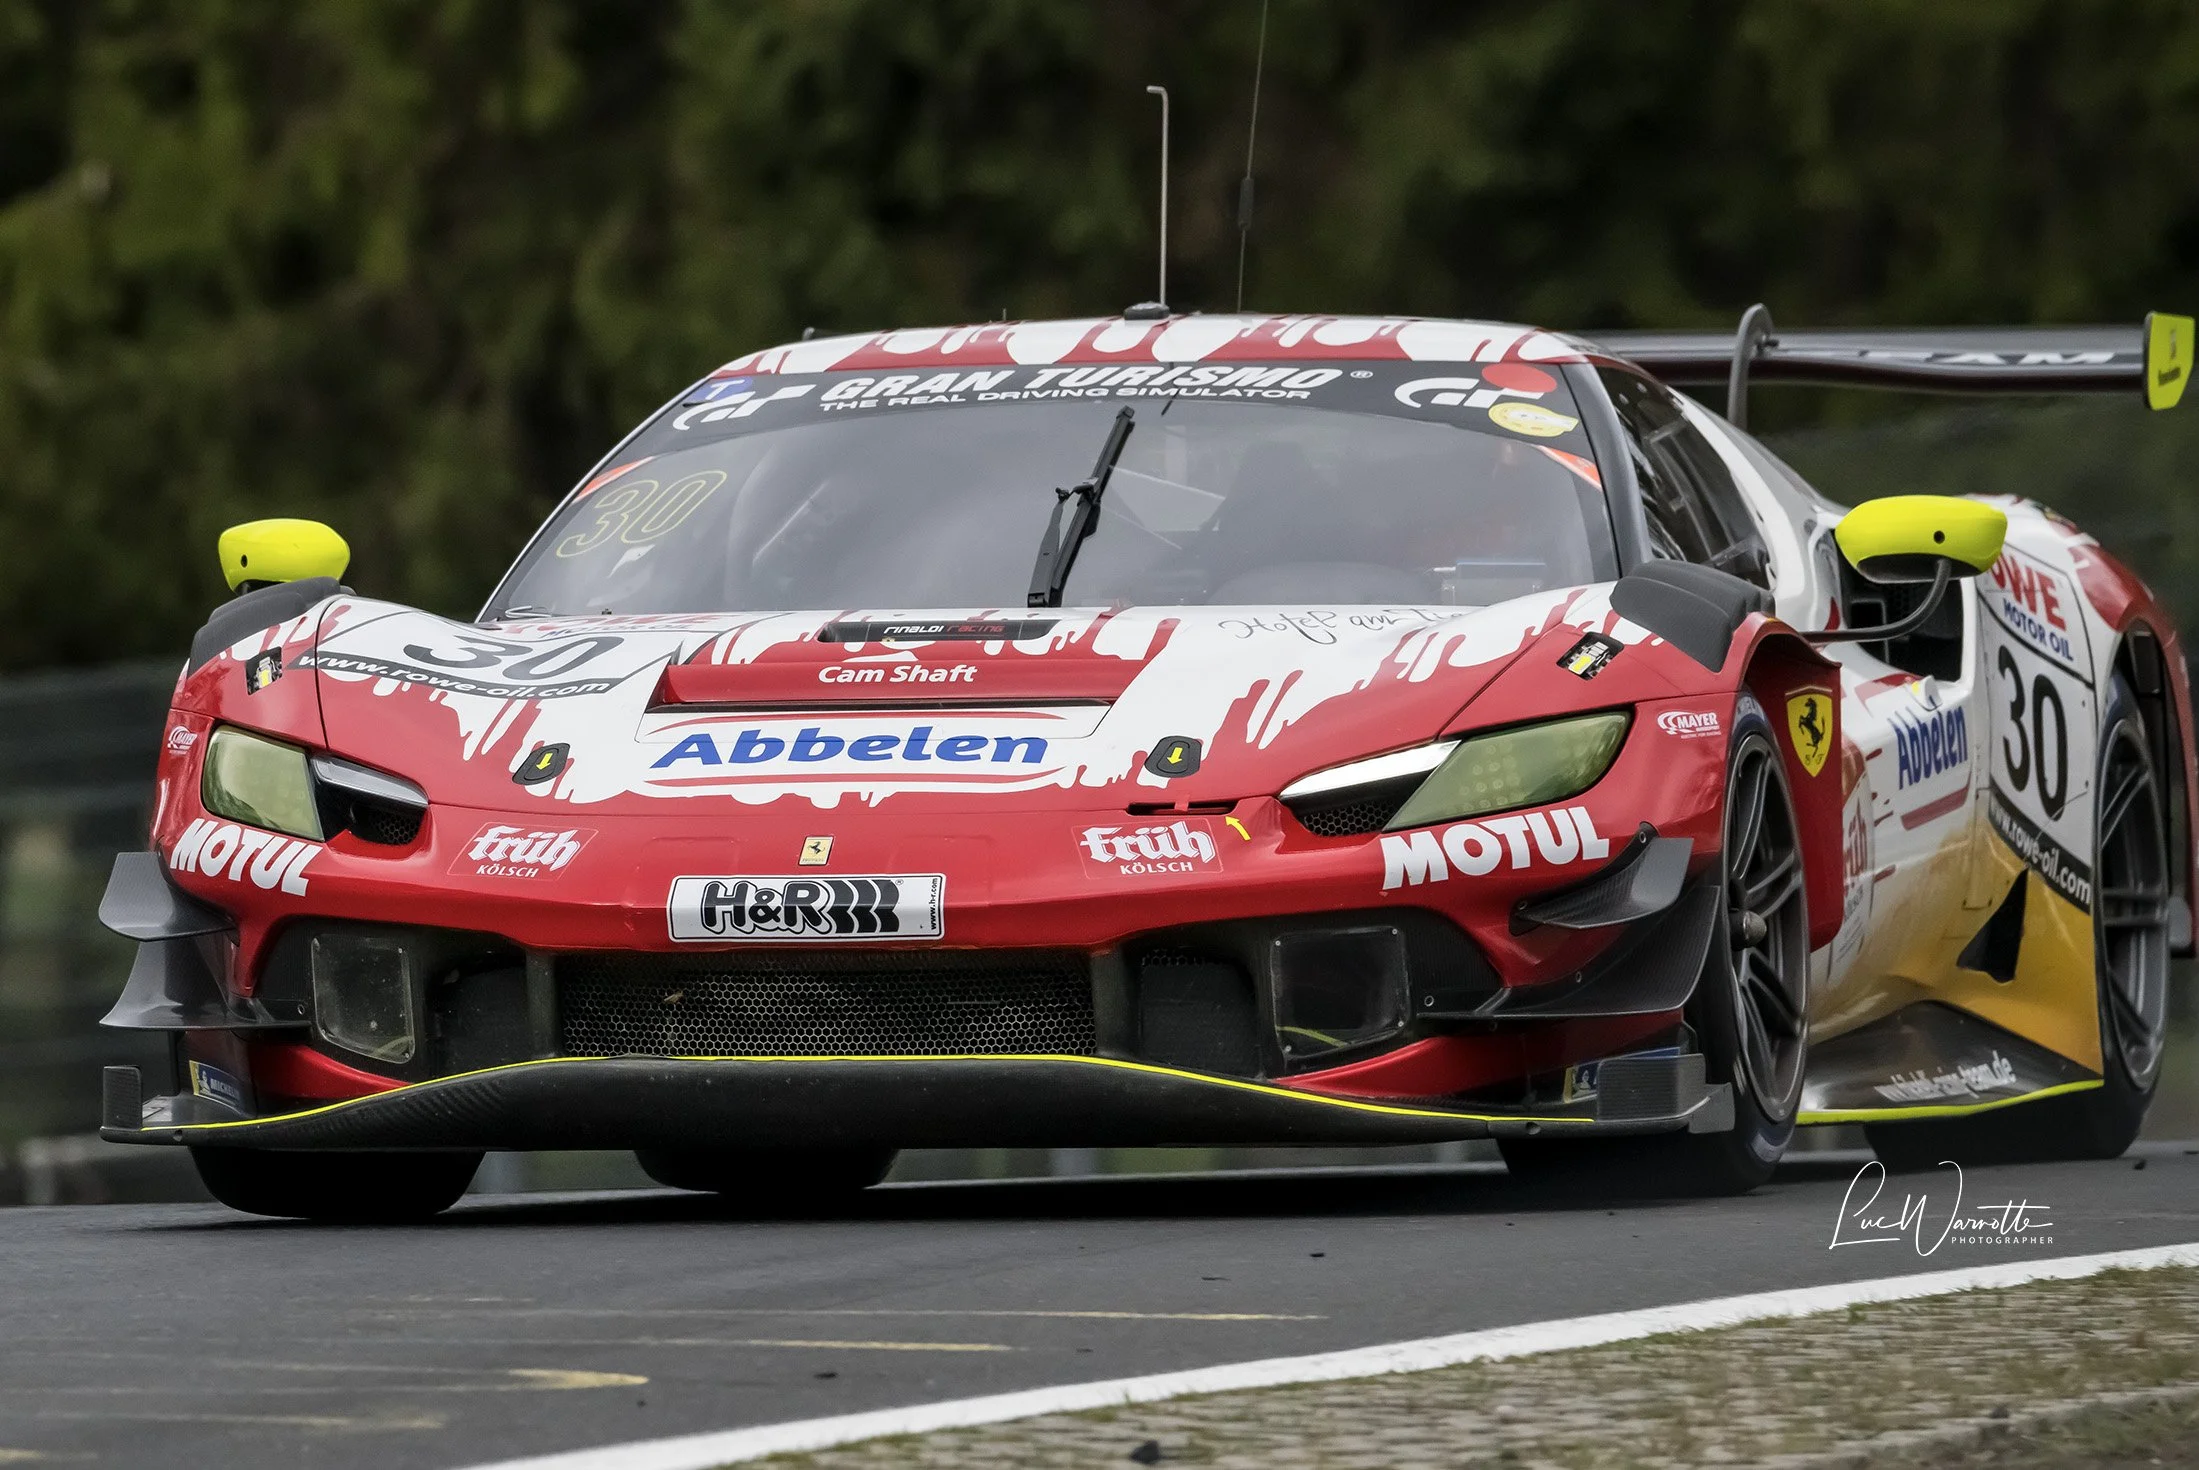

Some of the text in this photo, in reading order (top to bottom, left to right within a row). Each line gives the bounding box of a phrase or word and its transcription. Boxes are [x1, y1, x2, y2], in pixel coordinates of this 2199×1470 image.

[820, 387, 1311, 411] THE REAL DRIVING SIMULATOR
[821, 366, 1344, 401] GRAN TURISMO
[556, 470, 728, 558] 30
[1989, 552, 2067, 632] OWE
[2003, 597, 2074, 662] MOTOR OIL
[299, 654, 610, 698] www.rowe-oil.com
[403, 635, 625, 680] 30
[818, 663, 978, 684] Cam Shaft
[1676, 712, 1719, 729] MAYER
[1889, 694, 1970, 791] Abbelen
[1998, 644, 2069, 823] 30
[649, 726, 1049, 769] Abbelen
[170, 818, 324, 897] MOTUL
[476, 863, 539, 878] KÖLSCH
[1119, 862, 1194, 875] KÖLSCH
[1380, 806, 1610, 890] MOTUL
[702, 880, 831, 935] H&R
[929, 877, 938, 931] www.h-r.com
